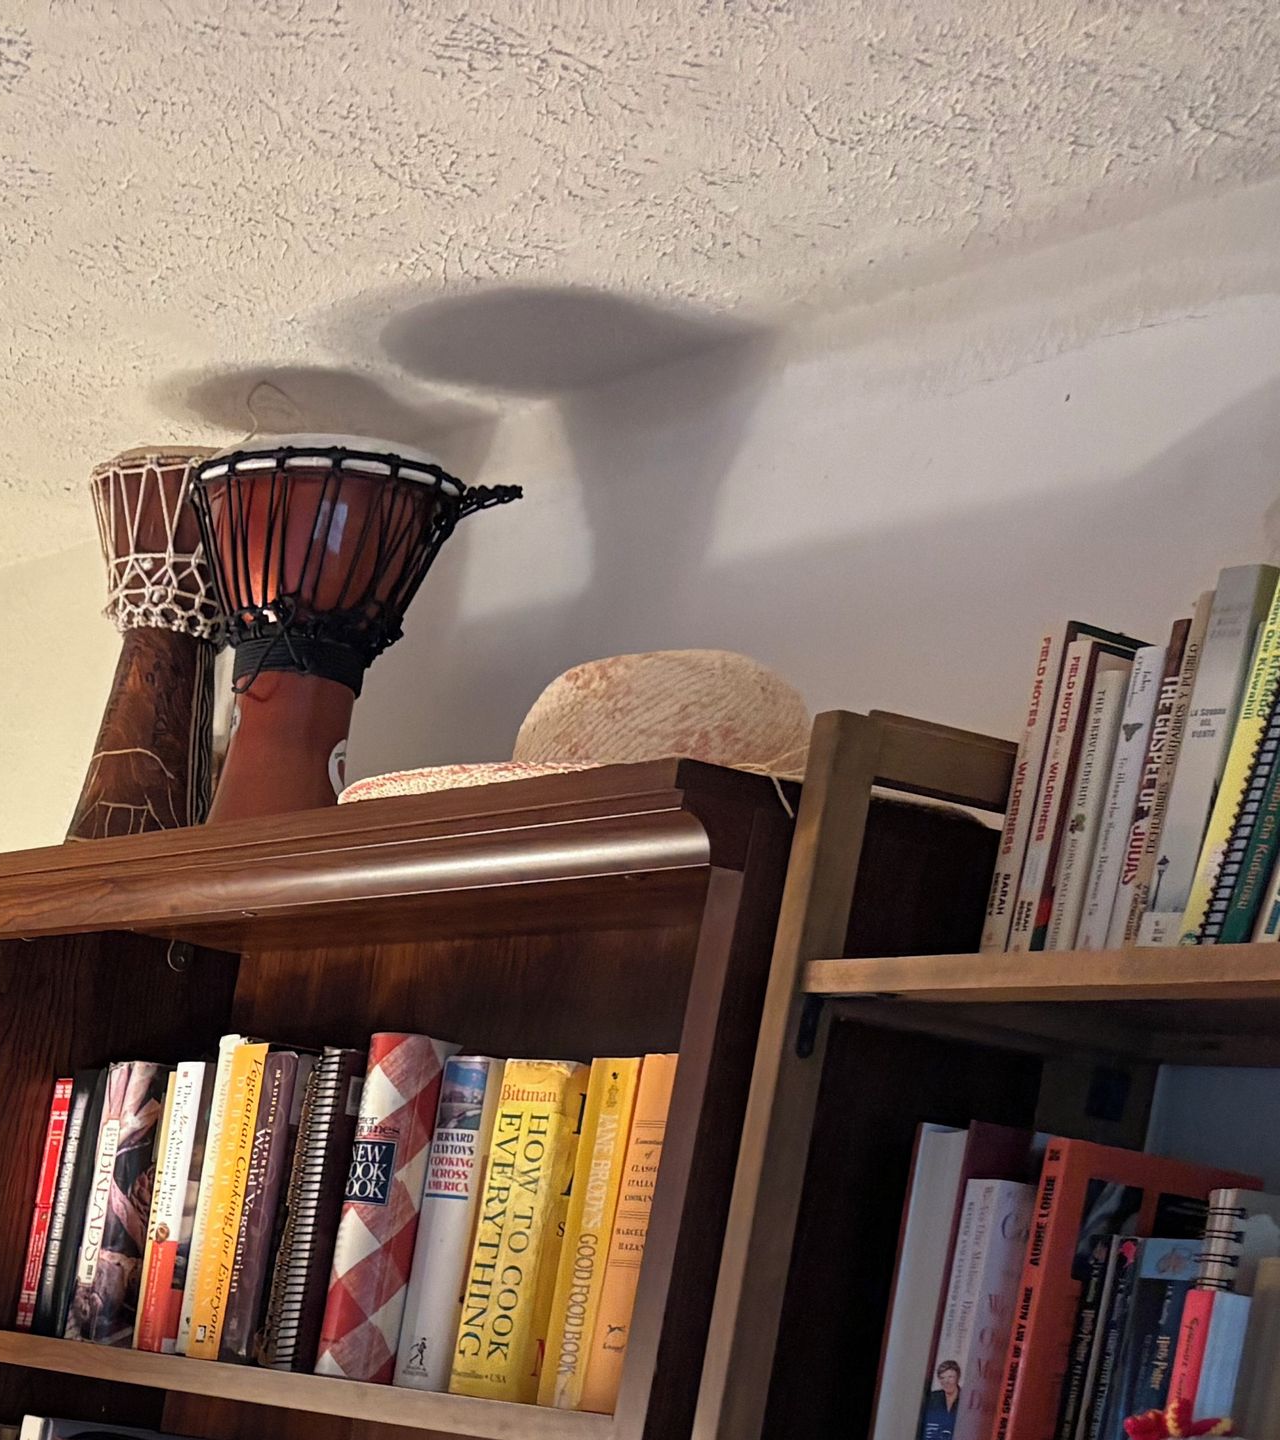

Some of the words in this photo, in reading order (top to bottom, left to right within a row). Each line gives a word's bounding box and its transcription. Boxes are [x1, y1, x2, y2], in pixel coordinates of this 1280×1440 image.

[1035, 636, 1050, 677] FIELD
[1066, 655, 1080, 690] FIELD
[1026, 679, 1043, 727] NOTES
[1056, 691, 1072, 733] NOTES
[1158, 671, 1180, 713] THE
[1141, 714, 1170, 789] GOSPEL
[1001, 760, 1027, 856] WILDERNESS
[1035, 760, 1058, 841] WILDERNESS
[1120, 824, 1148, 887] JUDAS
[995, 873, 1011, 915] SARAH
[237, 1057, 263, 1150] Vegetarian
[500, 1083, 557, 1103] Bittman
[245, 1127, 266, 1186] World
[525, 1111, 550, 1195] HOW
[593, 1112, 619, 1156] JANE
[427, 1181, 469, 1193] AMERICA
[430, 1157, 474, 1169] COOKING
[430, 1169, 469, 1180] ACROSS
[83, 1152, 117, 1266] BREADS
[222, 1154, 247, 1228] Cooking
[580, 1156, 611, 1230] BRODY'S
[218, 1231, 235, 1258] for
[225, 1191, 256, 1293] Vegetarian
[458, 1111, 523, 1357] EVERYTHING
[507, 1206, 535, 1255] TO
[572, 1231, 599, 1281] GOOD
[204, 1262, 230, 1345] Everyone
[486, 1273, 523, 1362] COOK
[564, 1282, 590, 1328] FOOD
[556, 1329, 582, 1377] BOOK
